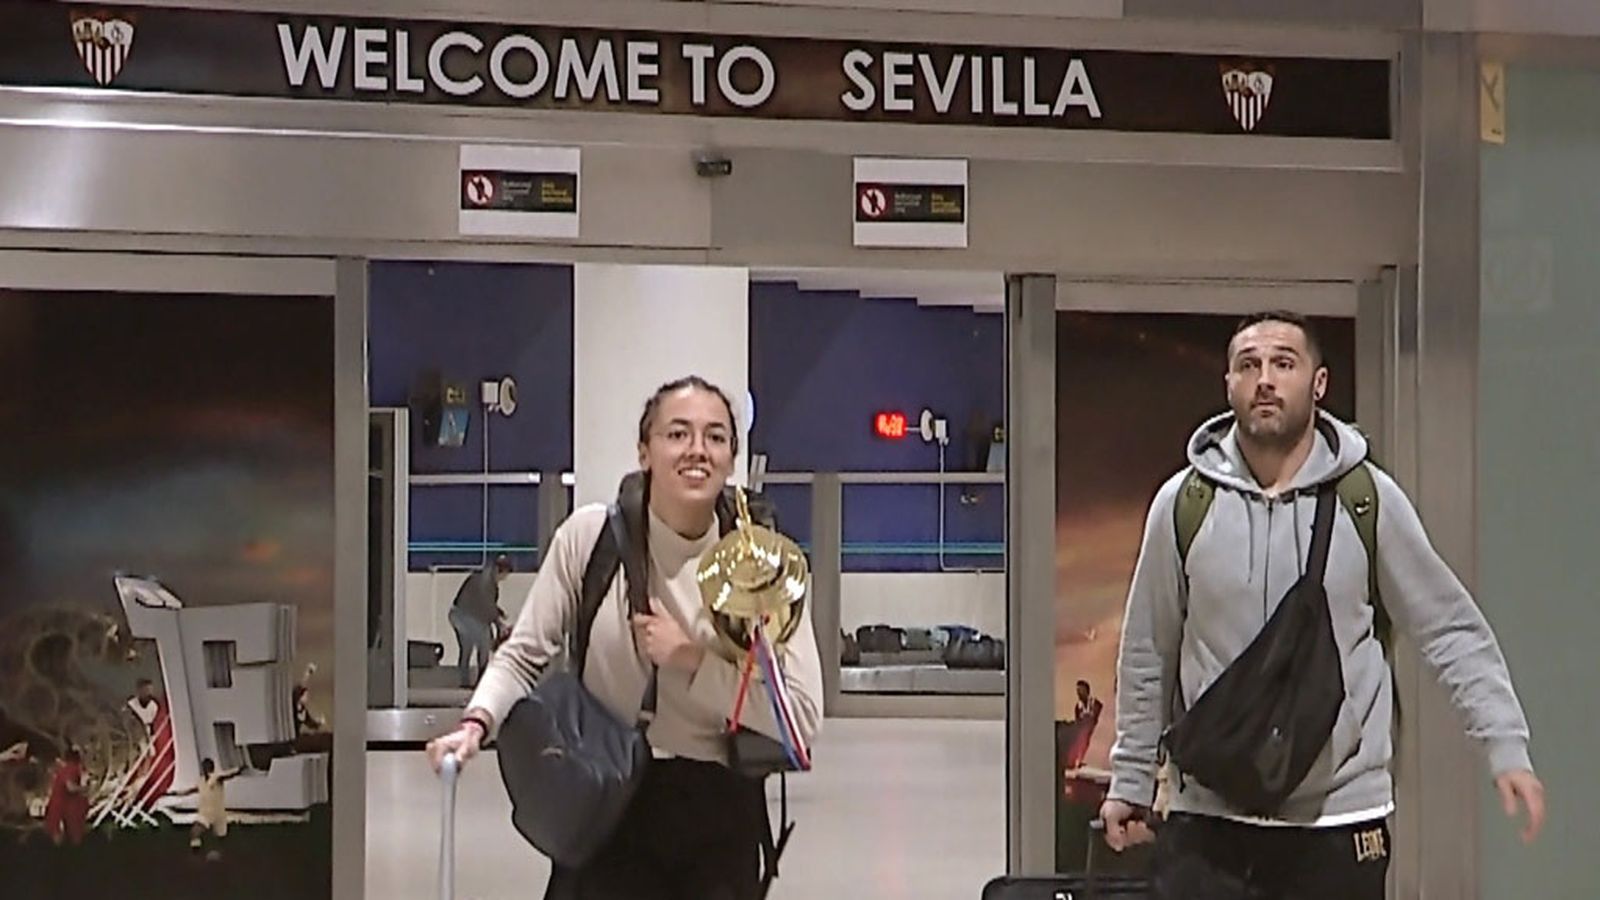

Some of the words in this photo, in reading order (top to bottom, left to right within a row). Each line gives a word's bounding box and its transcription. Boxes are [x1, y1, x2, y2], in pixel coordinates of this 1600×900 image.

[277, 23, 659, 105] WELCOME
[682, 43, 775, 108] TO
[841, 48, 1102, 119] SEVILLA
